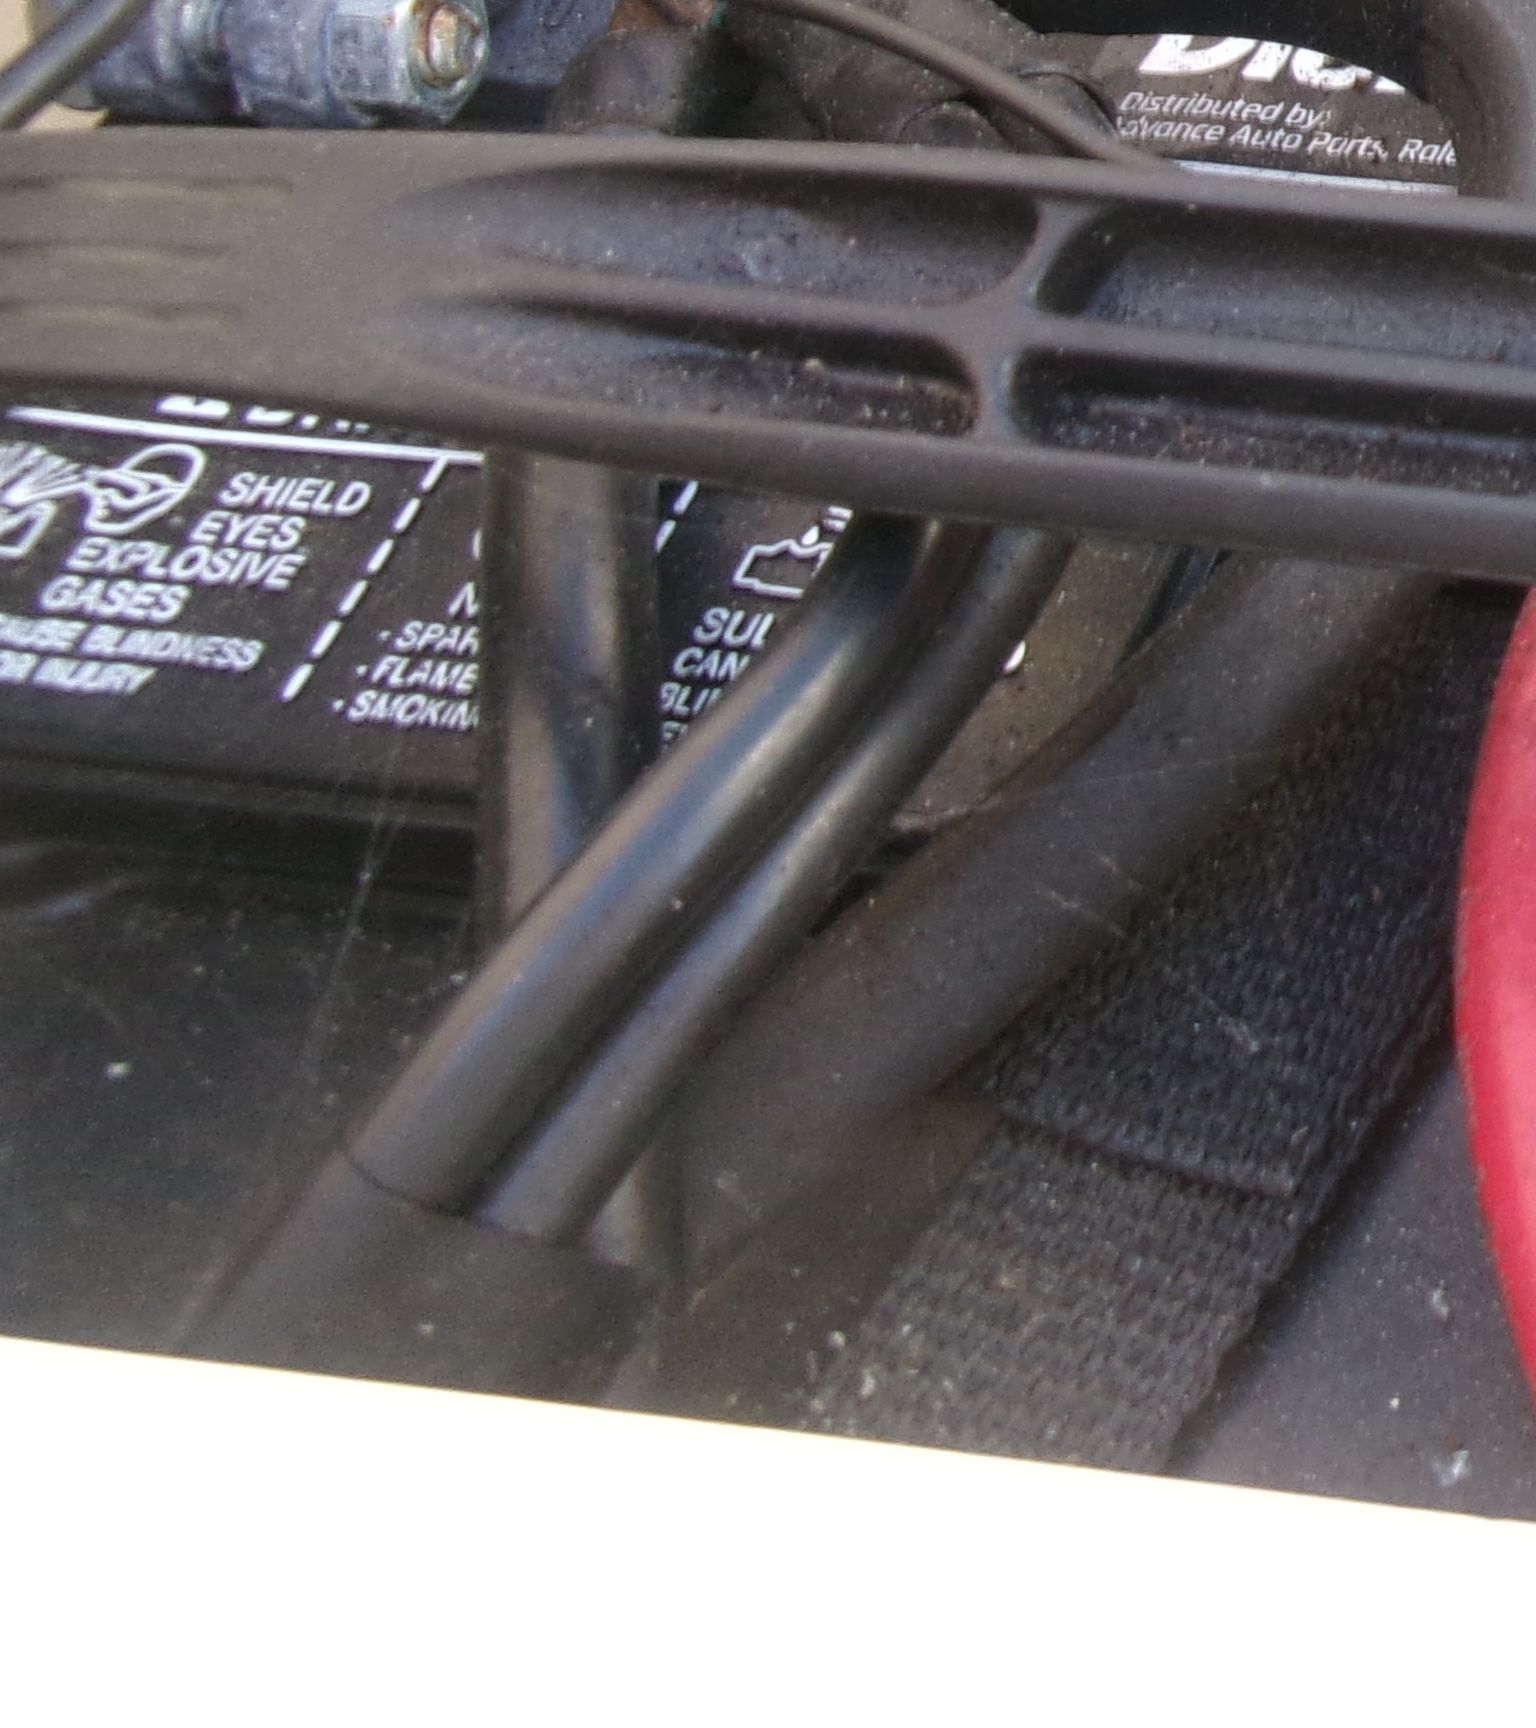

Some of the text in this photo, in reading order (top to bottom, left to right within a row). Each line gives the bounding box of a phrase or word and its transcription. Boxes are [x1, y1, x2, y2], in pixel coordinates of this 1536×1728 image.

[1120, 90, 1284, 124] Distributed
[1228, 123, 1303, 153] Auto
[1398, 137, 1457, 168] Rale
[220, 470, 372, 515] SHIELD
[66, 535, 307, 591] EXPLOSIVE
[40, 573, 192, 622] GASES
[370, 654, 480, 696] FLAME
[672, 646, 751, 682] CAN
[347, 688, 481, 732] SMOKIN
